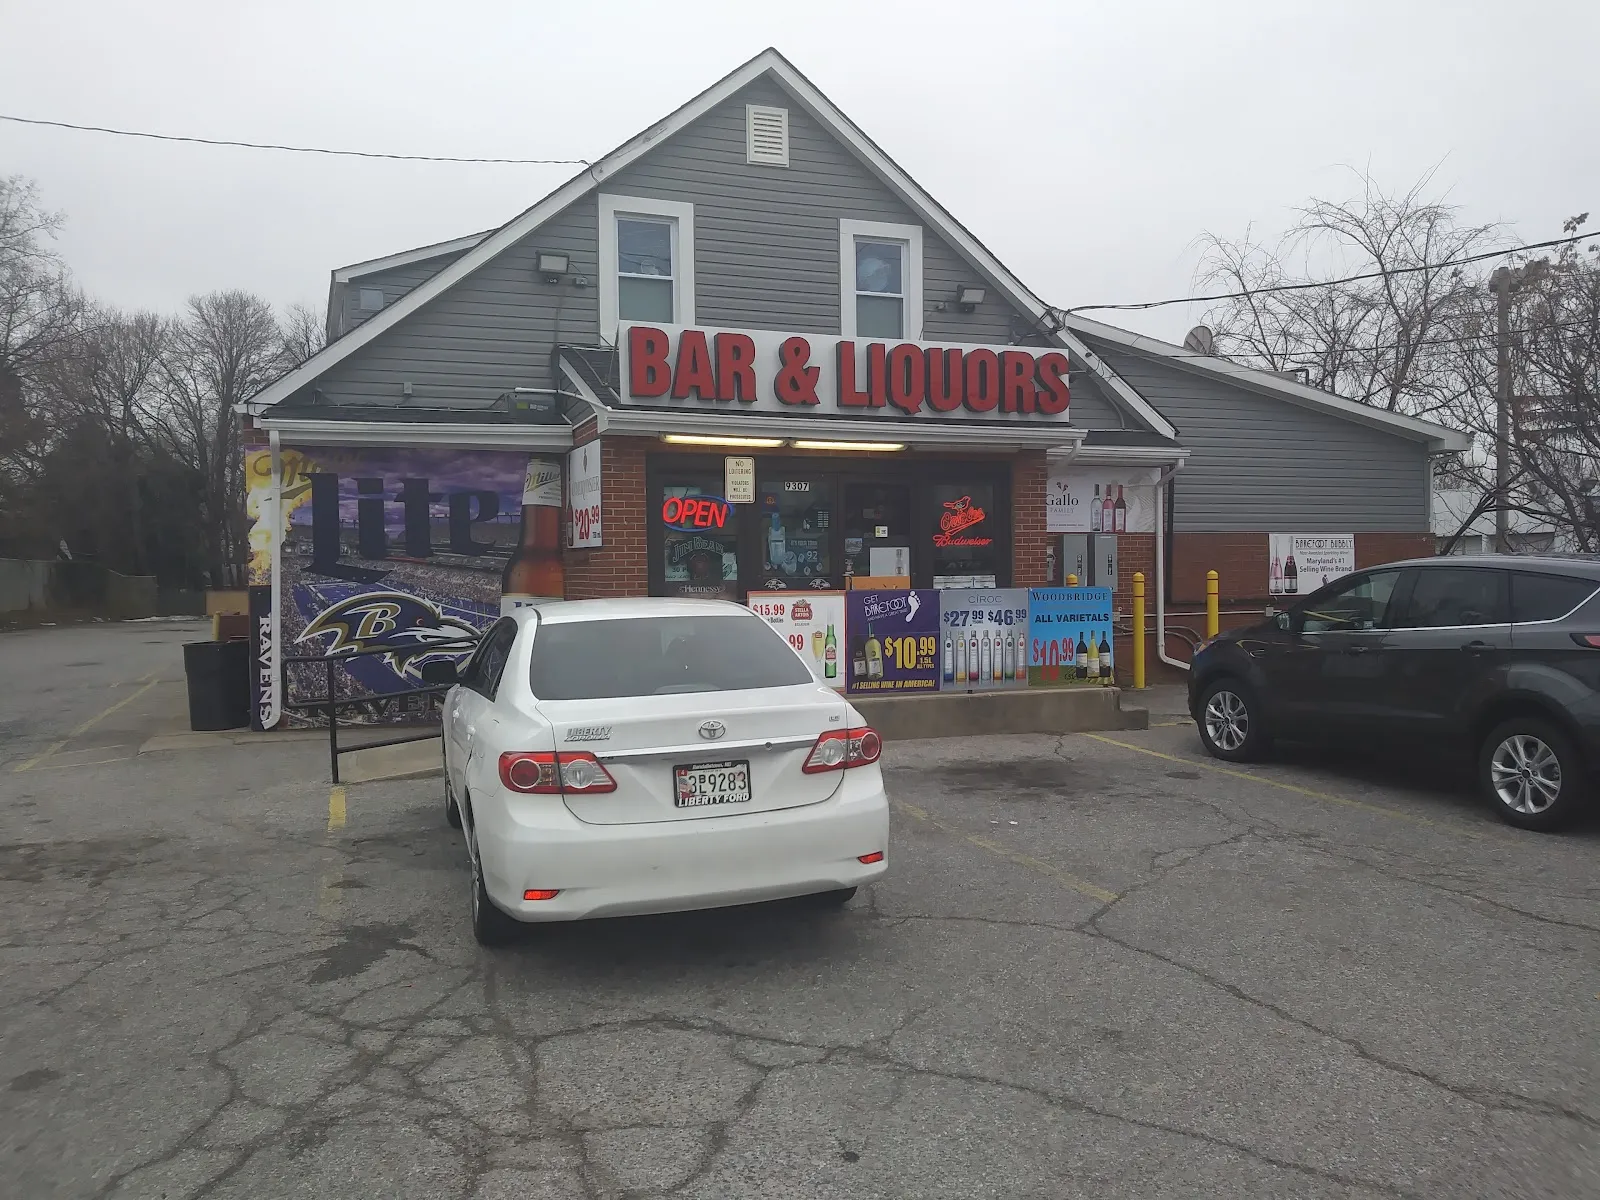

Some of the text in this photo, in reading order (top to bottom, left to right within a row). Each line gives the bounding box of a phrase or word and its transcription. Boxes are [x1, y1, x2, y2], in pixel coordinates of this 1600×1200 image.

[628, 326, 1070, 414] BAR & LIQUORS
[785, 482, 808, 490] 9307
[1045, 493, 1079, 506] Gallo
[663, 497, 727, 528] OPEN
[298, 472, 499, 584] Lite
[575, 505, 599, 539] $20.99
[933, 535, 992, 546] Budweiser
[1295, 540, 1328, 548] BAREFOOT
[806, 551, 818, 560] 92
[683, 585, 722, 593] Hennessy
[864, 595, 879, 604] GET
[1032, 592, 1109, 601] WOODBRIDGE
[753, 604, 785, 616] $15.99
[864, 596, 907, 616] BAREFOOT
[944, 608, 1027, 627] $27.99 $46.99
[1034, 613, 1110, 623] ALL VARIETALS
[884, 636, 936, 669] $10.99
[1033, 637, 1074, 681] $10.99
[258, 613, 272, 730] RAVENS
[903, 680, 936, 688] AMERICA!
[566, 726, 613, 736] LIBERTY
[678, 792, 750, 807] LIBERTY FORD
